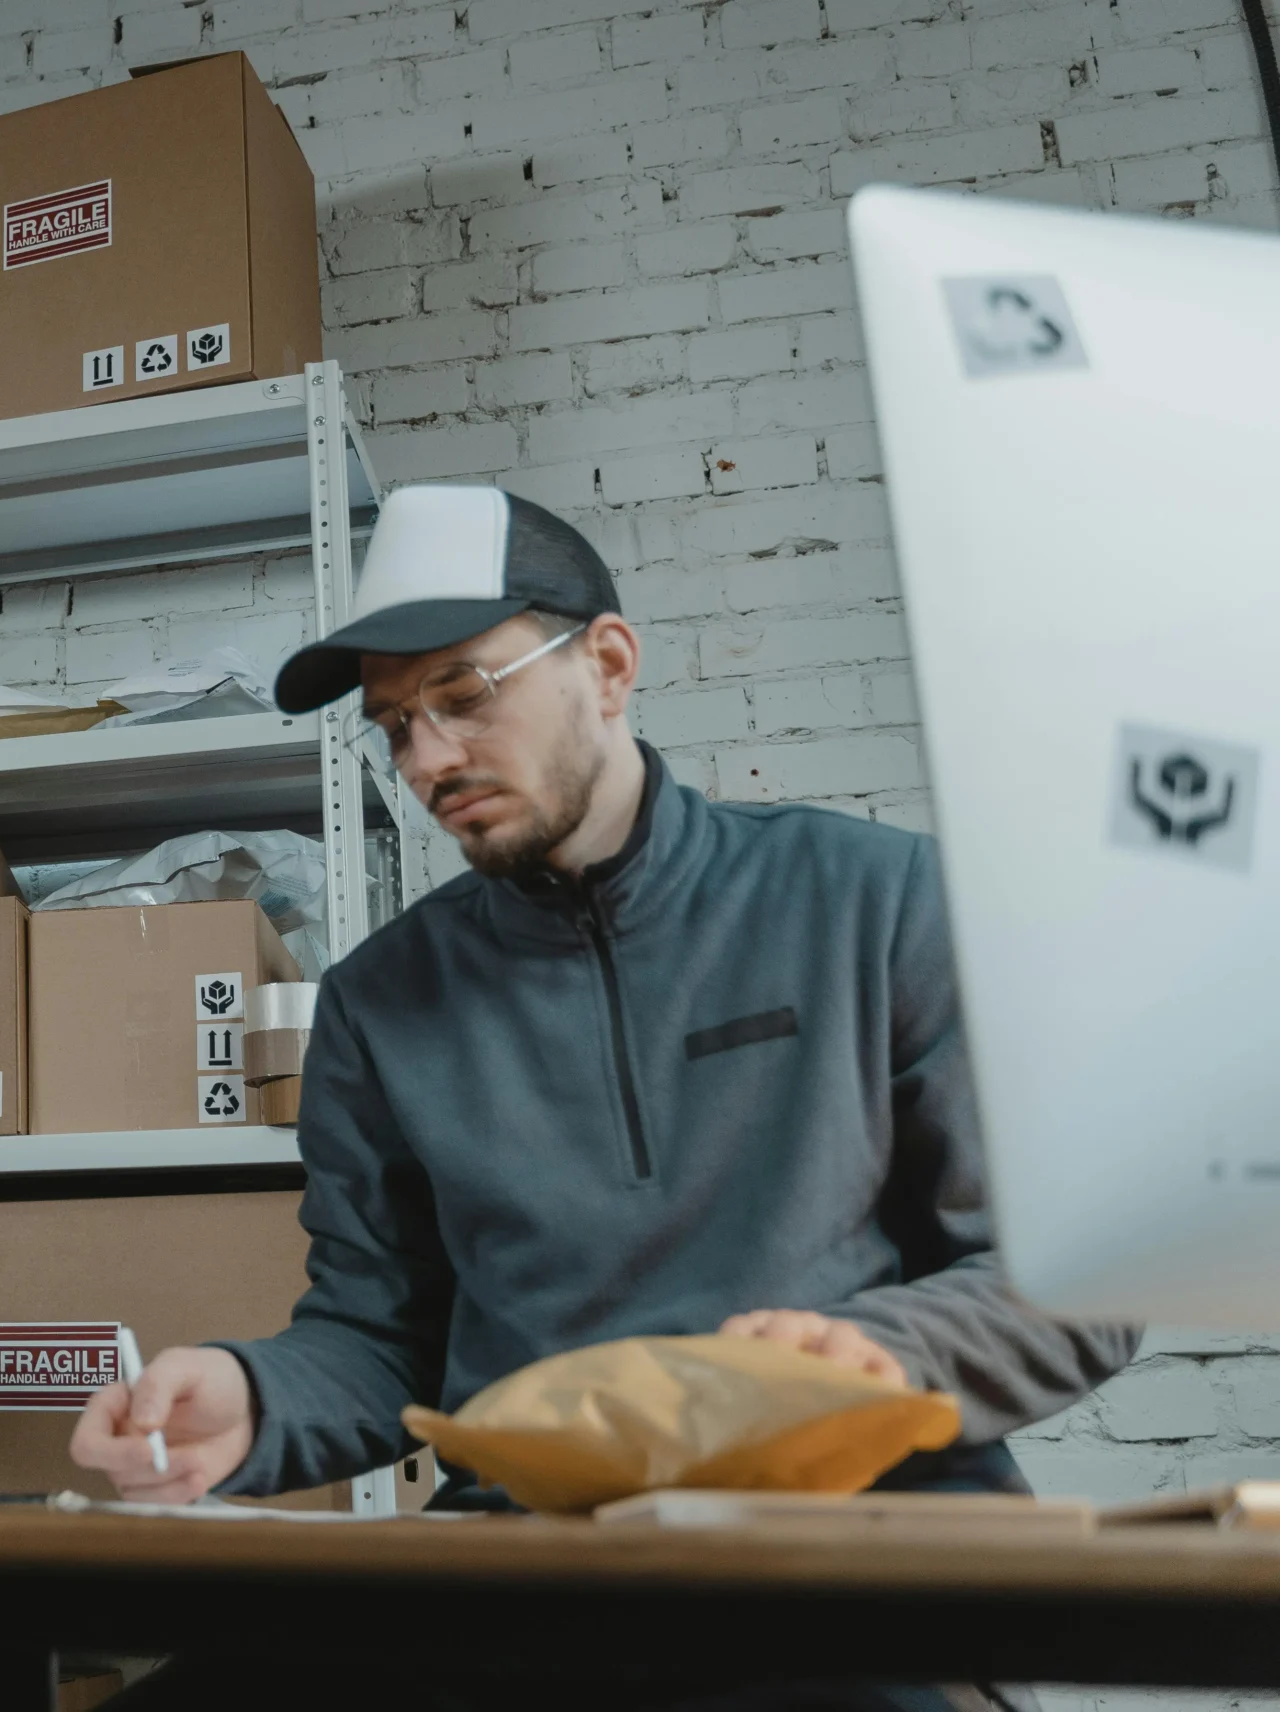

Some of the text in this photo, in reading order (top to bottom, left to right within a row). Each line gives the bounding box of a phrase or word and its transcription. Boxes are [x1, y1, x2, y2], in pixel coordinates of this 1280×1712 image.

[8, 201, 106, 241] FRAGILE
[8, 219, 106, 250] HANDLE WITH CARE
[0, 1349, 115, 1373] FRAGILE
[0, 1373, 115, 1384] HANDLE WITH CARE
